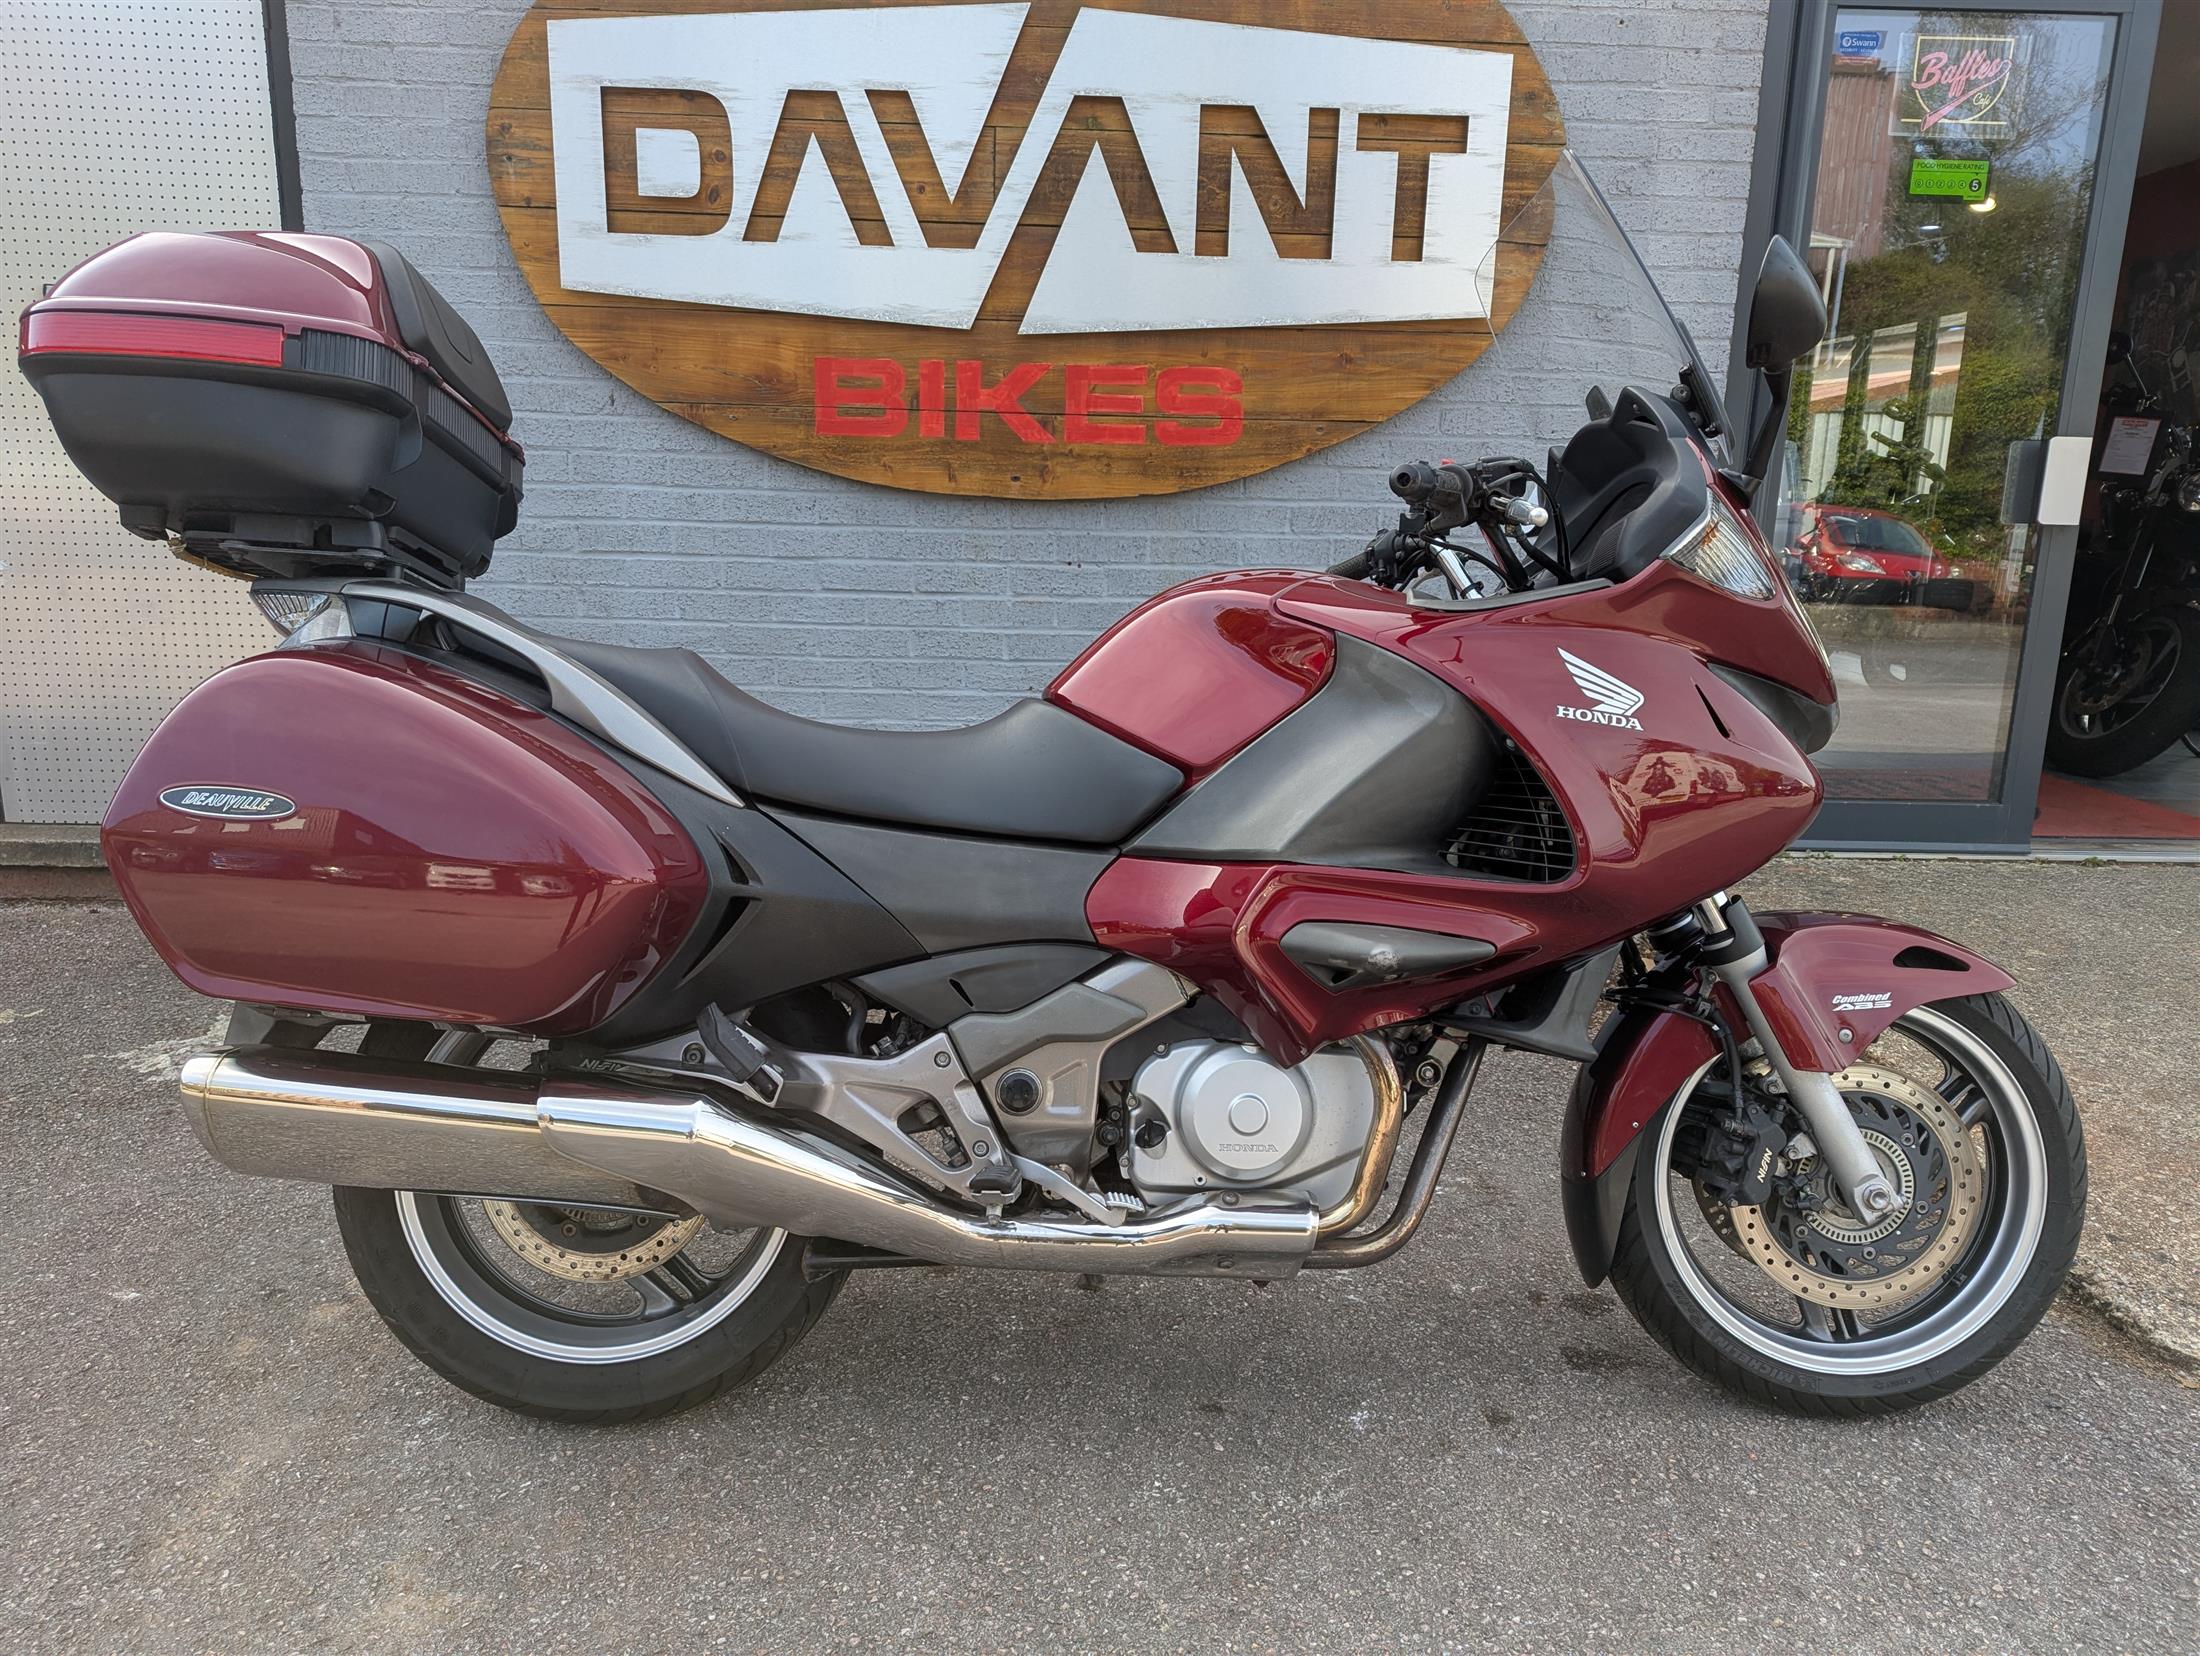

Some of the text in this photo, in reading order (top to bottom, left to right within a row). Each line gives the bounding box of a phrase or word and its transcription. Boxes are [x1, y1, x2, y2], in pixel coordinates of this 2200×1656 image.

[1851, 38, 1877, 47] Swann
[1911, 49, 2001, 98] Baffles
[598, 84, 1472, 264] DAVANT
[1916, 161, 1936, 169] FOOD
[1963, 163, 1985, 171] RATING
[1971, 180, 1979, 191] 5
[813, 355, 1246, 447] BIKES
[1556, 705, 1645, 732] HONDA
[180, 791, 274, 812] DEAUVILLE
[1832, 991, 1892, 1004] Combined
[1832, 1000, 1893, 1012] ABS
[1218, 1143, 1279, 1153] HONDA
[1757, 1147, 1773, 1184] NISSIN
